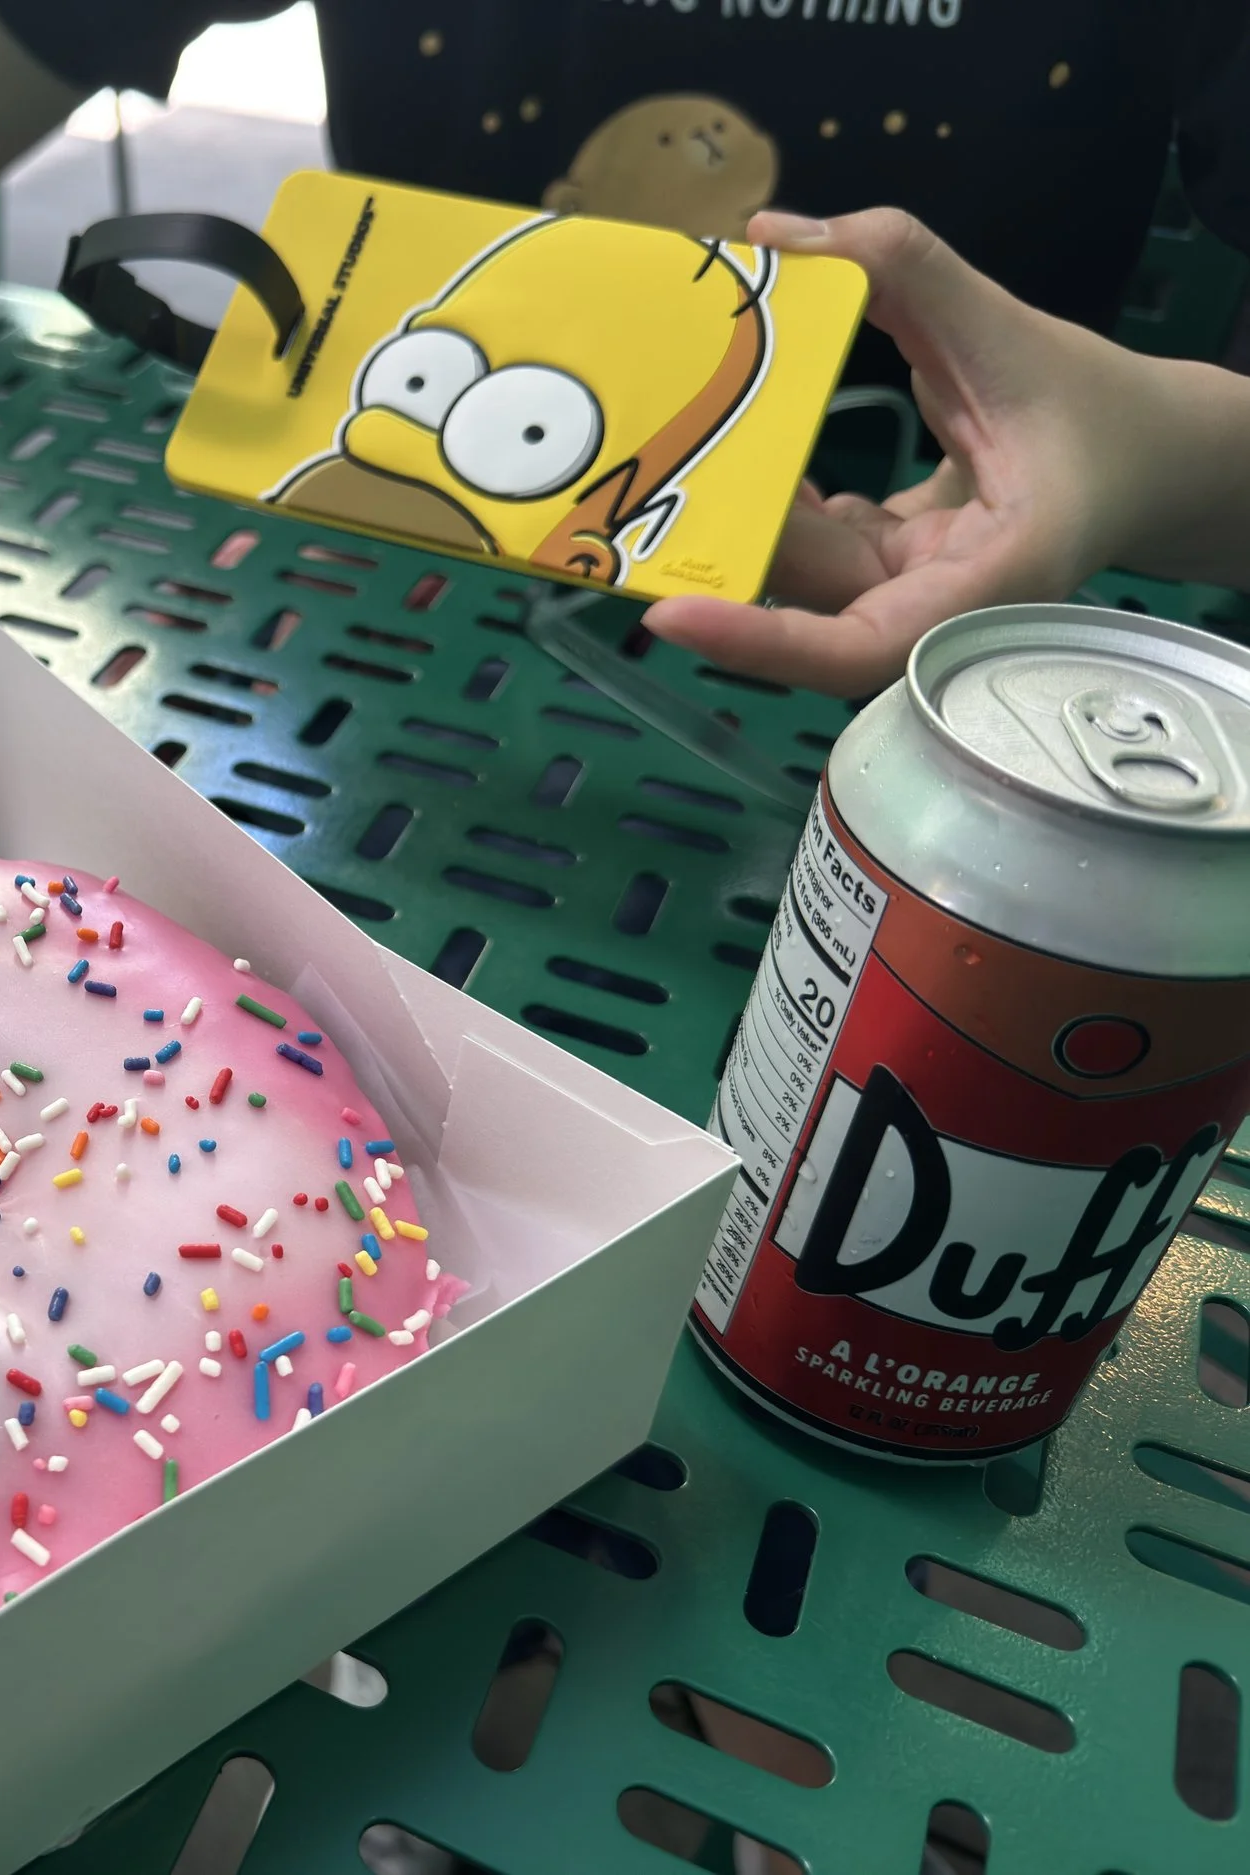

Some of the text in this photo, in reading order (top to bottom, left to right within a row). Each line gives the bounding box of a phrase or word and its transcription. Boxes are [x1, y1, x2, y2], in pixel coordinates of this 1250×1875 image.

[803, 853, 834, 912] container
[822, 839, 876, 915] Facts
[798, 977, 836, 1029] 20
[796, 1052, 813, 1074] 0%
[789, 1071, 806, 1093] 0%
[782, 1091, 799, 1113] 2%
[774, 1111, 791, 1133] 2%
[761, 1148, 778, 1170] 8%
[755, 1166, 771, 1187] 0%
[744, 1195, 760, 1217] 2%
[793, 1063, 1220, 1351] Duff
[734, 1207, 754, 1234] 25%
[726, 1224, 747, 1251] 25%
[715, 1258, 734, 1285] 25%
[794, 1346, 1054, 1415] SPARKLING BEVERAGE
[829, 1339, 1042, 1395] A L'ORANGE
